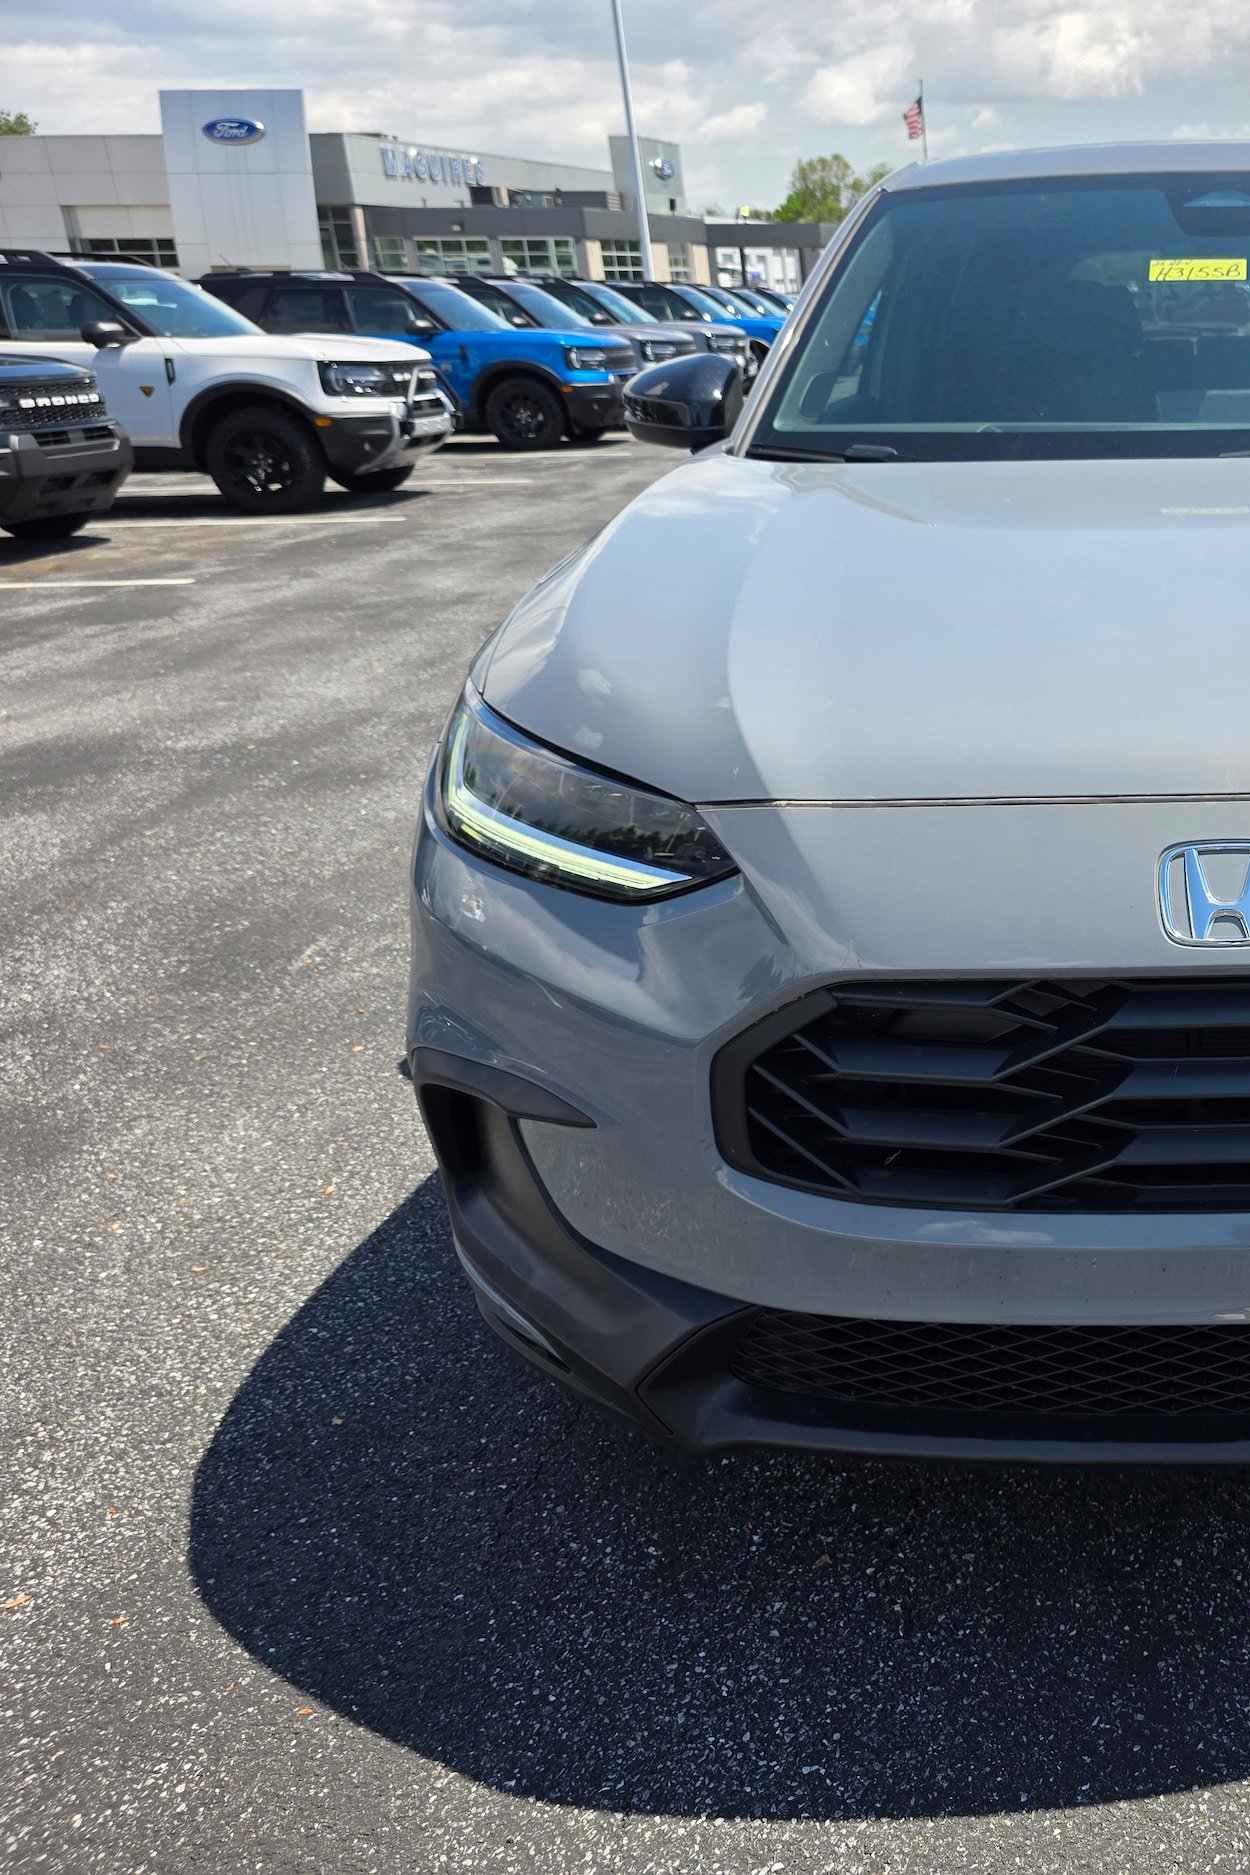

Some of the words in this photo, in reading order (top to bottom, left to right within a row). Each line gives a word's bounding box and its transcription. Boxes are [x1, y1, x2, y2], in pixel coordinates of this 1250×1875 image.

[214, 122, 249, 138] Ford
[382, 147, 486, 187] MAGUIRES
[18, 392, 100, 409] BRONCO
